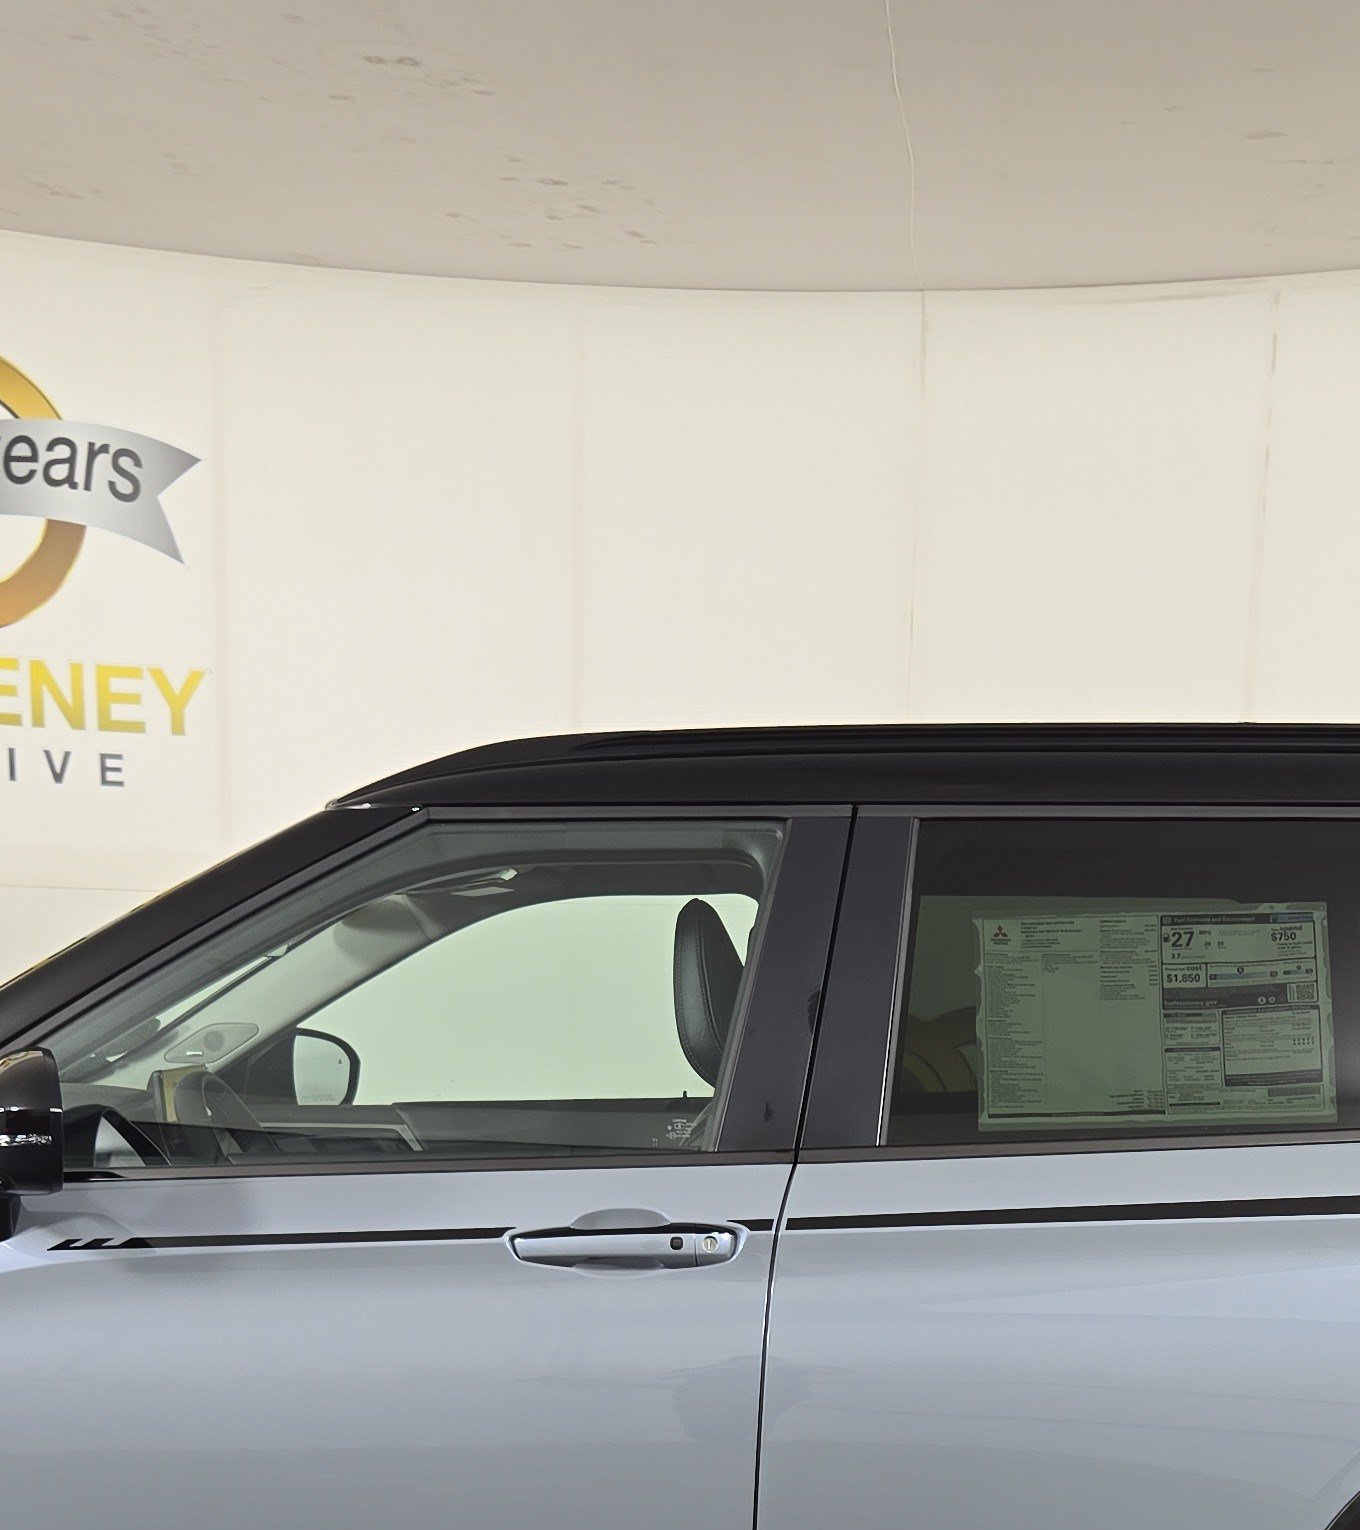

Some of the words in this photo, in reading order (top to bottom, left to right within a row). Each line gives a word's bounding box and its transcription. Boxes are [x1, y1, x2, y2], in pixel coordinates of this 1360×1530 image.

[1171, 931, 1195, 948] 27
[1271, 932, 1297, 942] $750
[1166, 973, 1201, 984] $1,850
